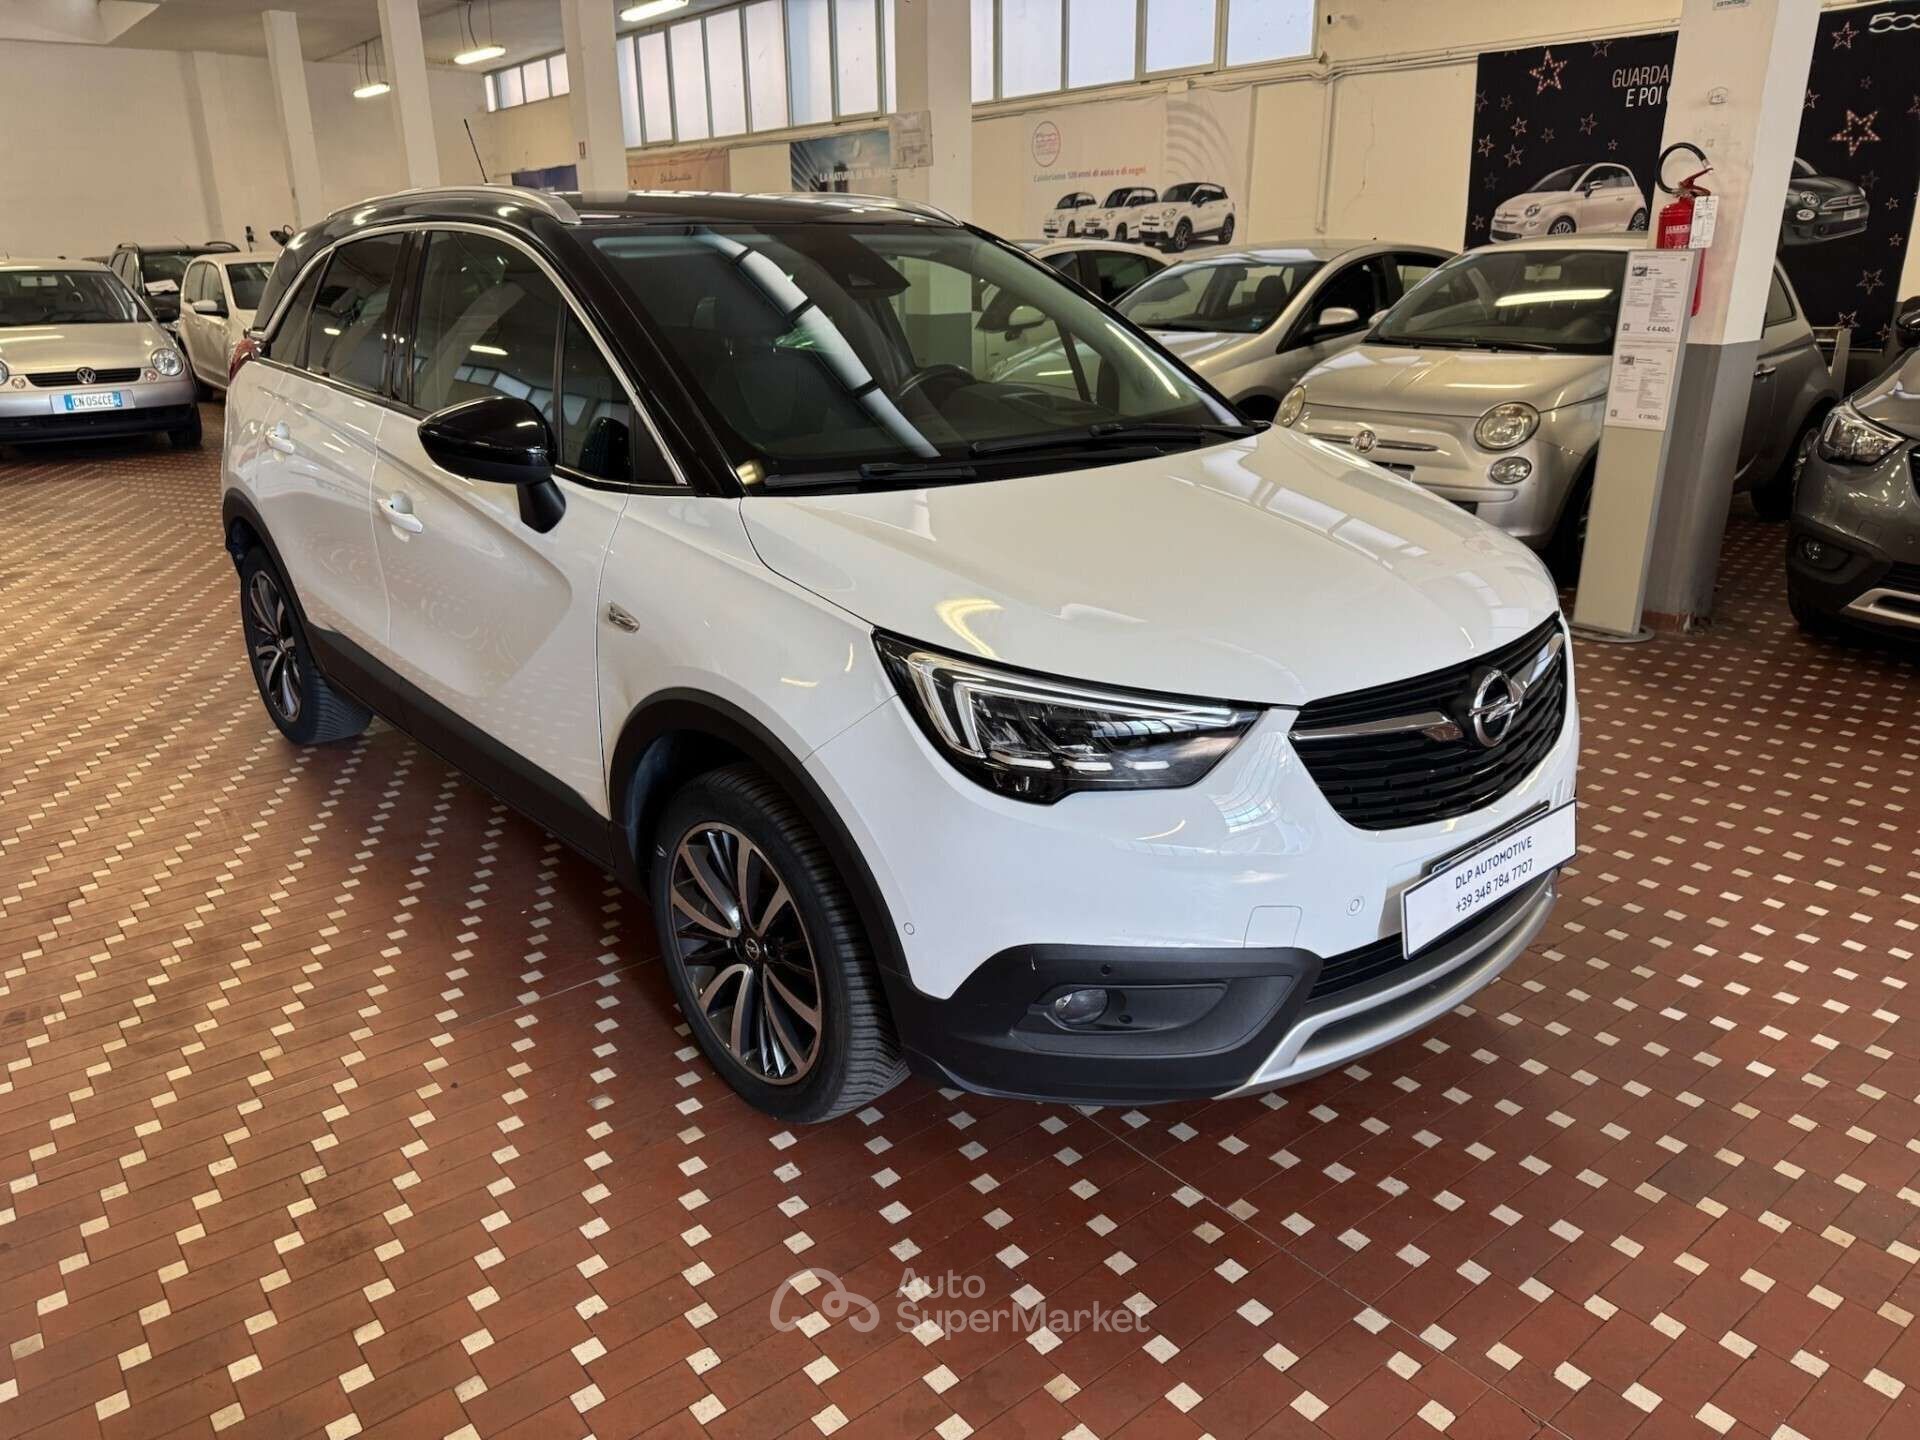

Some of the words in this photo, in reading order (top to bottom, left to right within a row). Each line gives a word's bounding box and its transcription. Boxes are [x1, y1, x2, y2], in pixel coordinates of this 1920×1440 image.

[1612, 64, 1670, 88] GUARDA
[1626, 88, 1636, 107] E
[1638, 86, 1663, 107] POI
[1455, 869, 1473, 890] DLP
[1474, 836, 1532, 879] AUTOMOTIVE
[1456, 893, 1473, 913] +39
[1474, 881, 1492, 904] 348
[1494, 872, 1510, 892] 784
[1511, 858, 1533, 881] 7707
